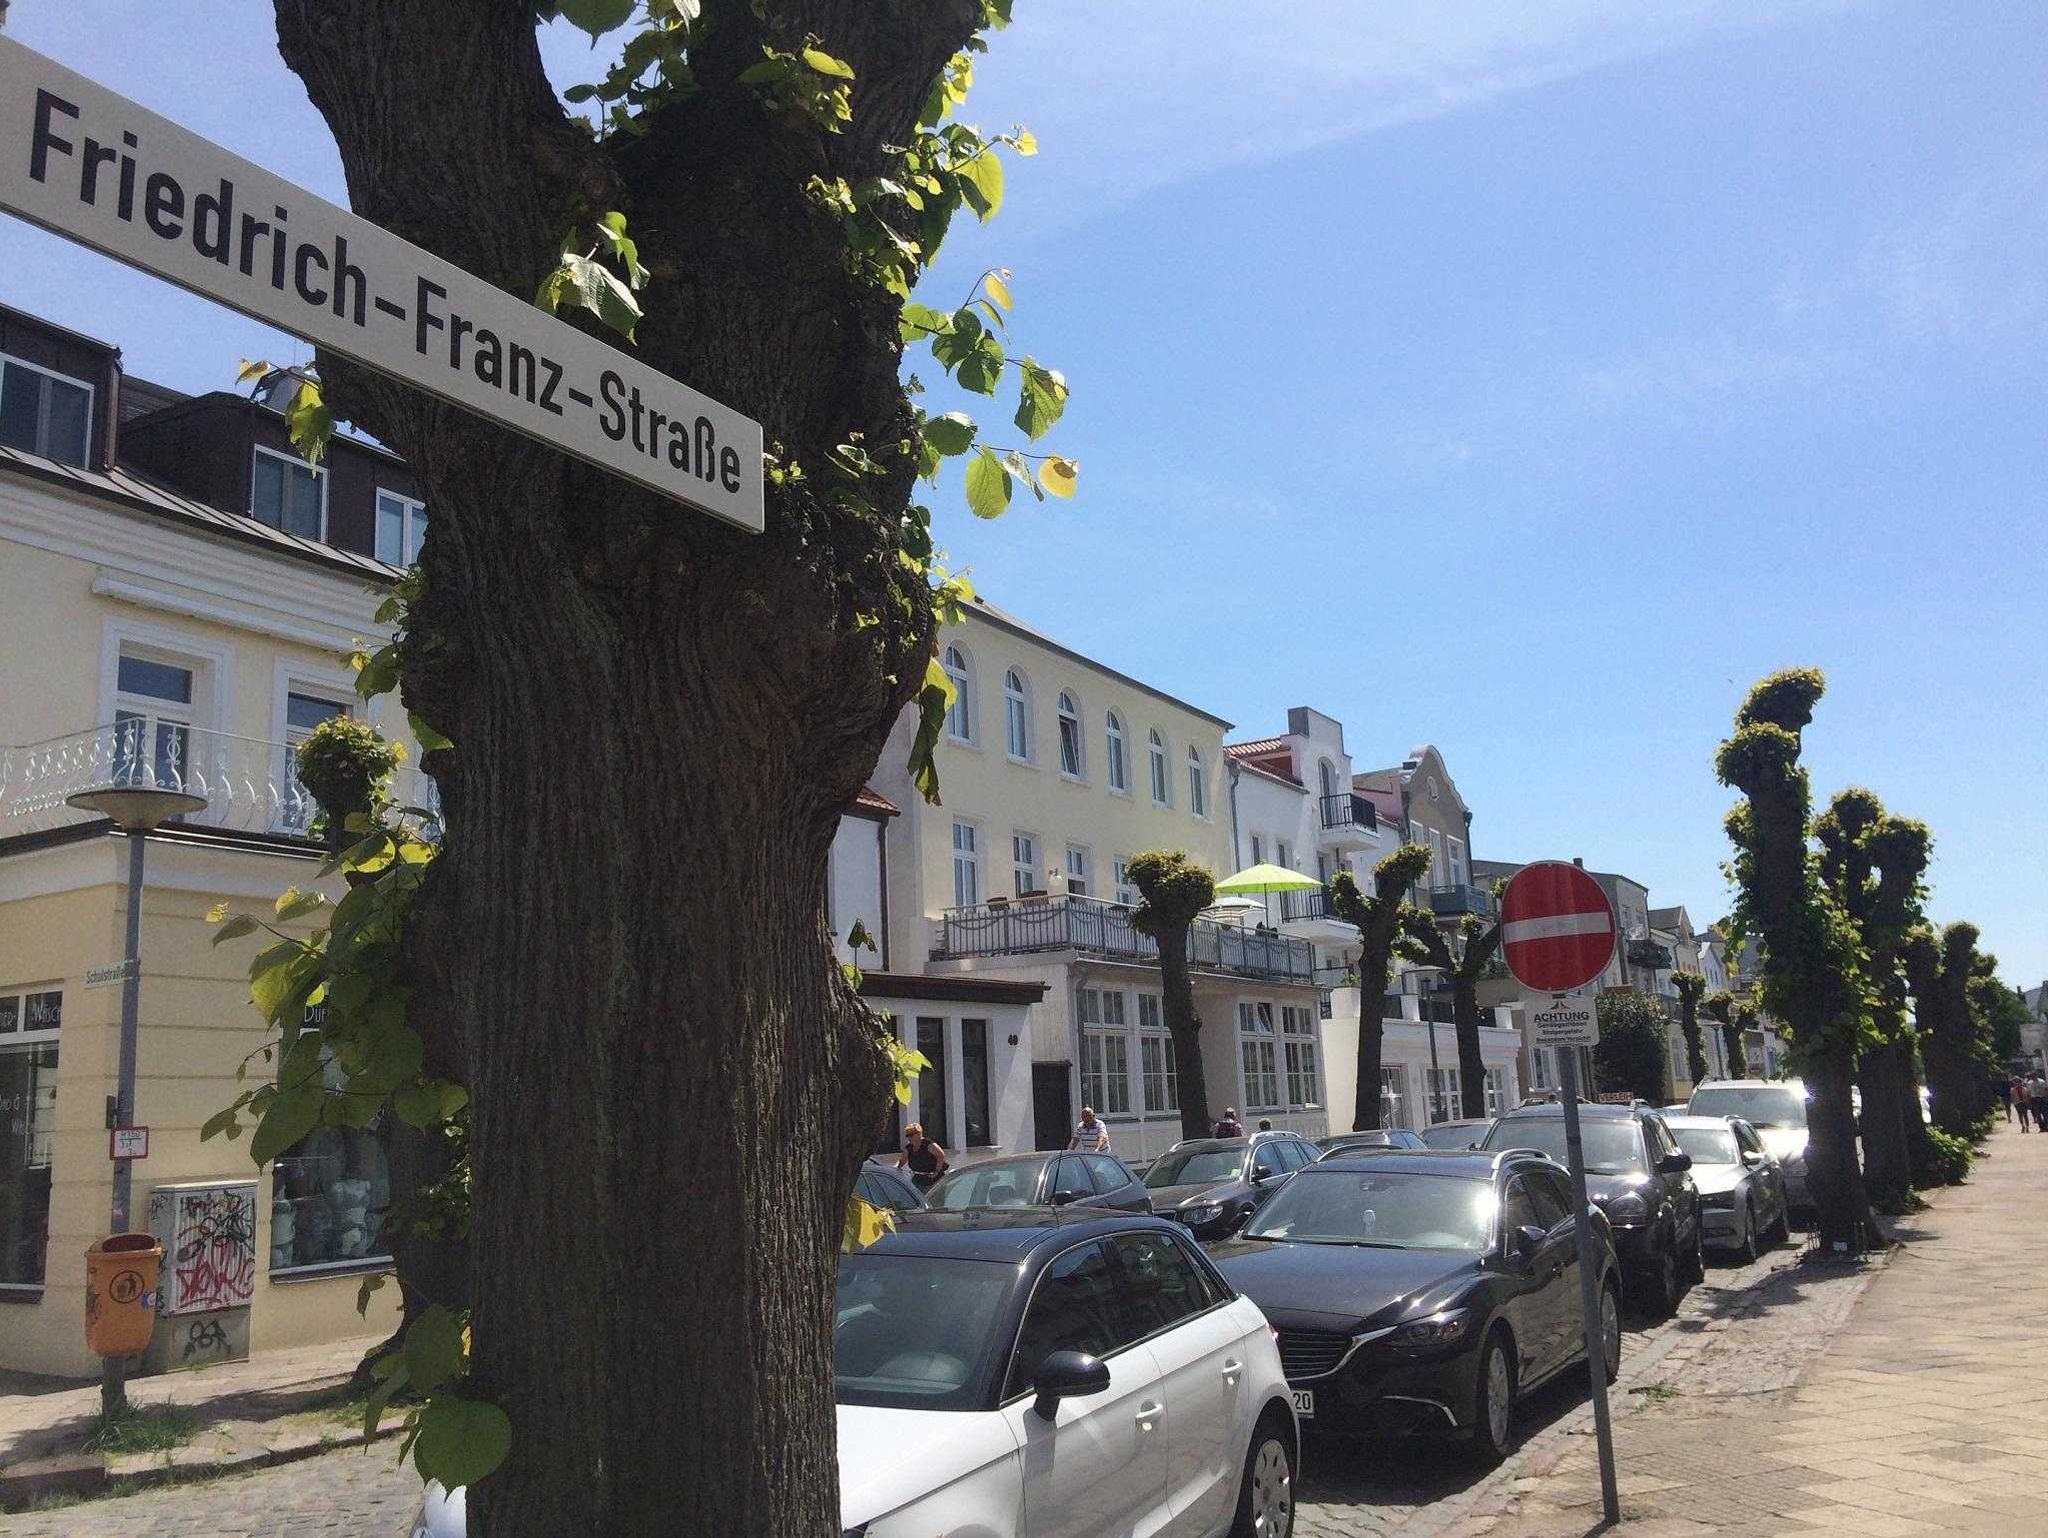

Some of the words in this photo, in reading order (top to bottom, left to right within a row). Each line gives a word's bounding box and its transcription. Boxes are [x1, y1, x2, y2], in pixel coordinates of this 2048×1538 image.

[29, 87, 742, 494] Friedrich-Franz-Straße
[86, 966, 126, 984] Schulstraße
[1534, 1011, 1590, 1022] ACHTUNG
[1293, 1392, 1311, 1410] 20
